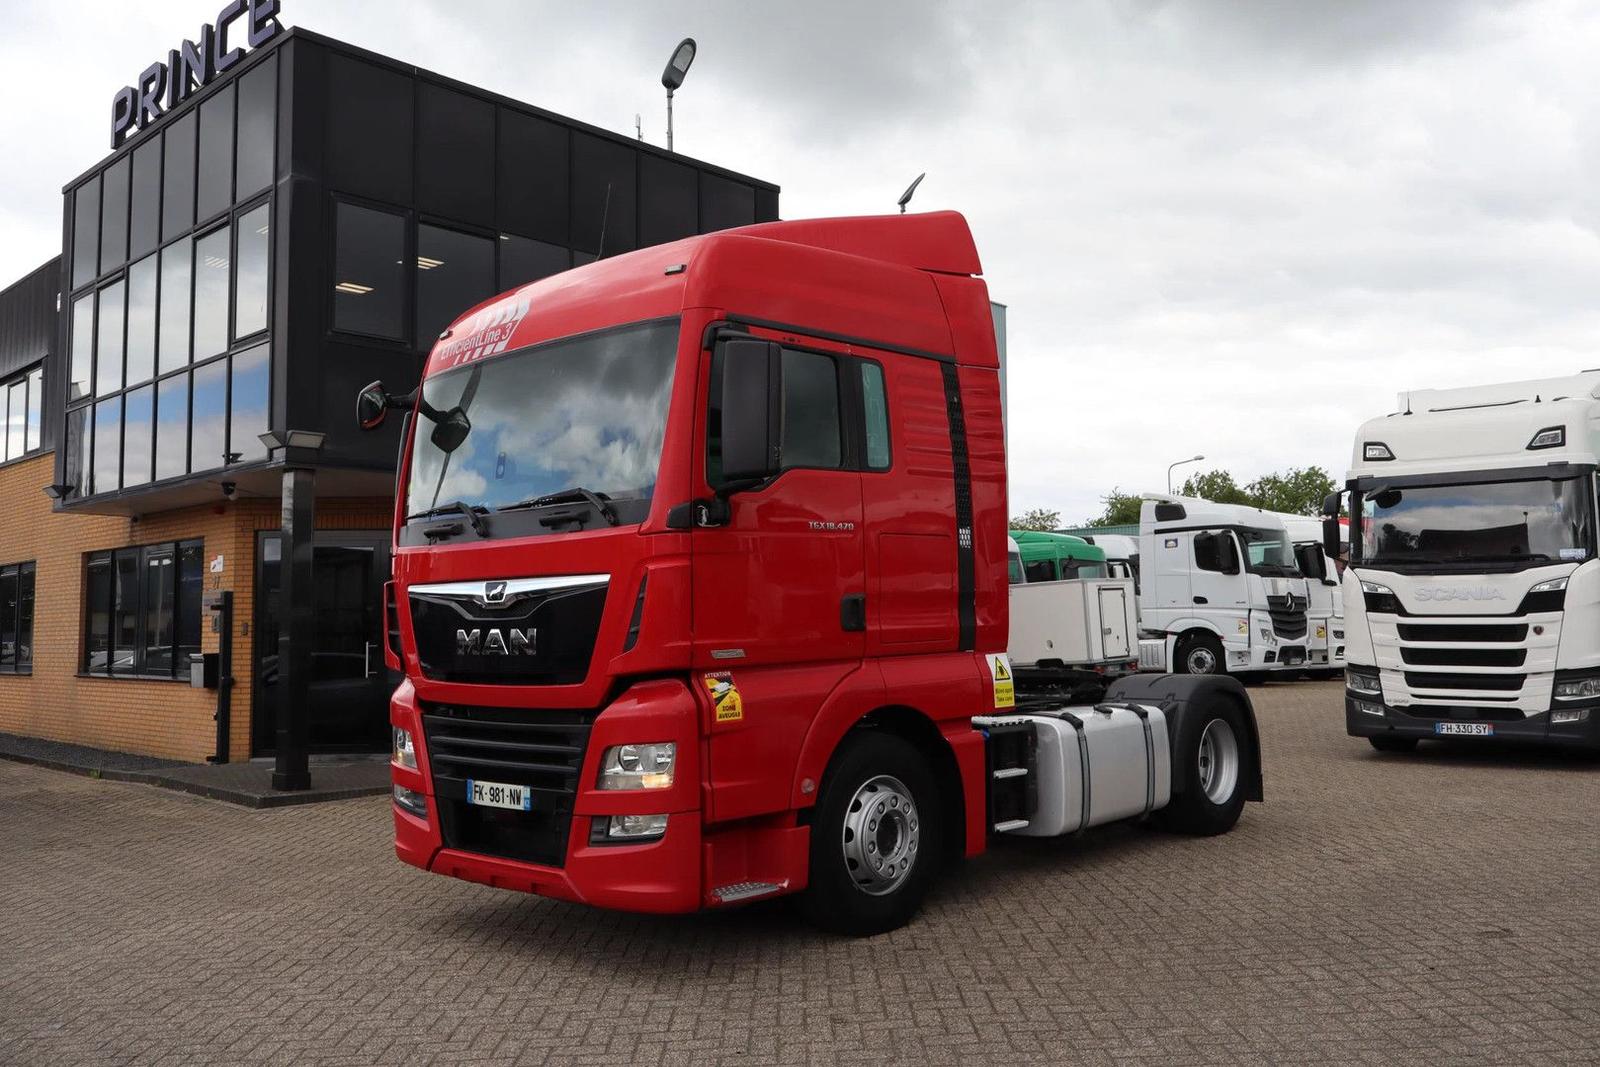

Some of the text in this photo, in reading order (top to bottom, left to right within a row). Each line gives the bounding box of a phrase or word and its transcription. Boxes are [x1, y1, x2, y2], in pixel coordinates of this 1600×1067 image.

[111, 0, 281, 150] PRINCE
[1415, 584, 1506, 601] SCANIA
[457, 628, 537, 655] MAN
